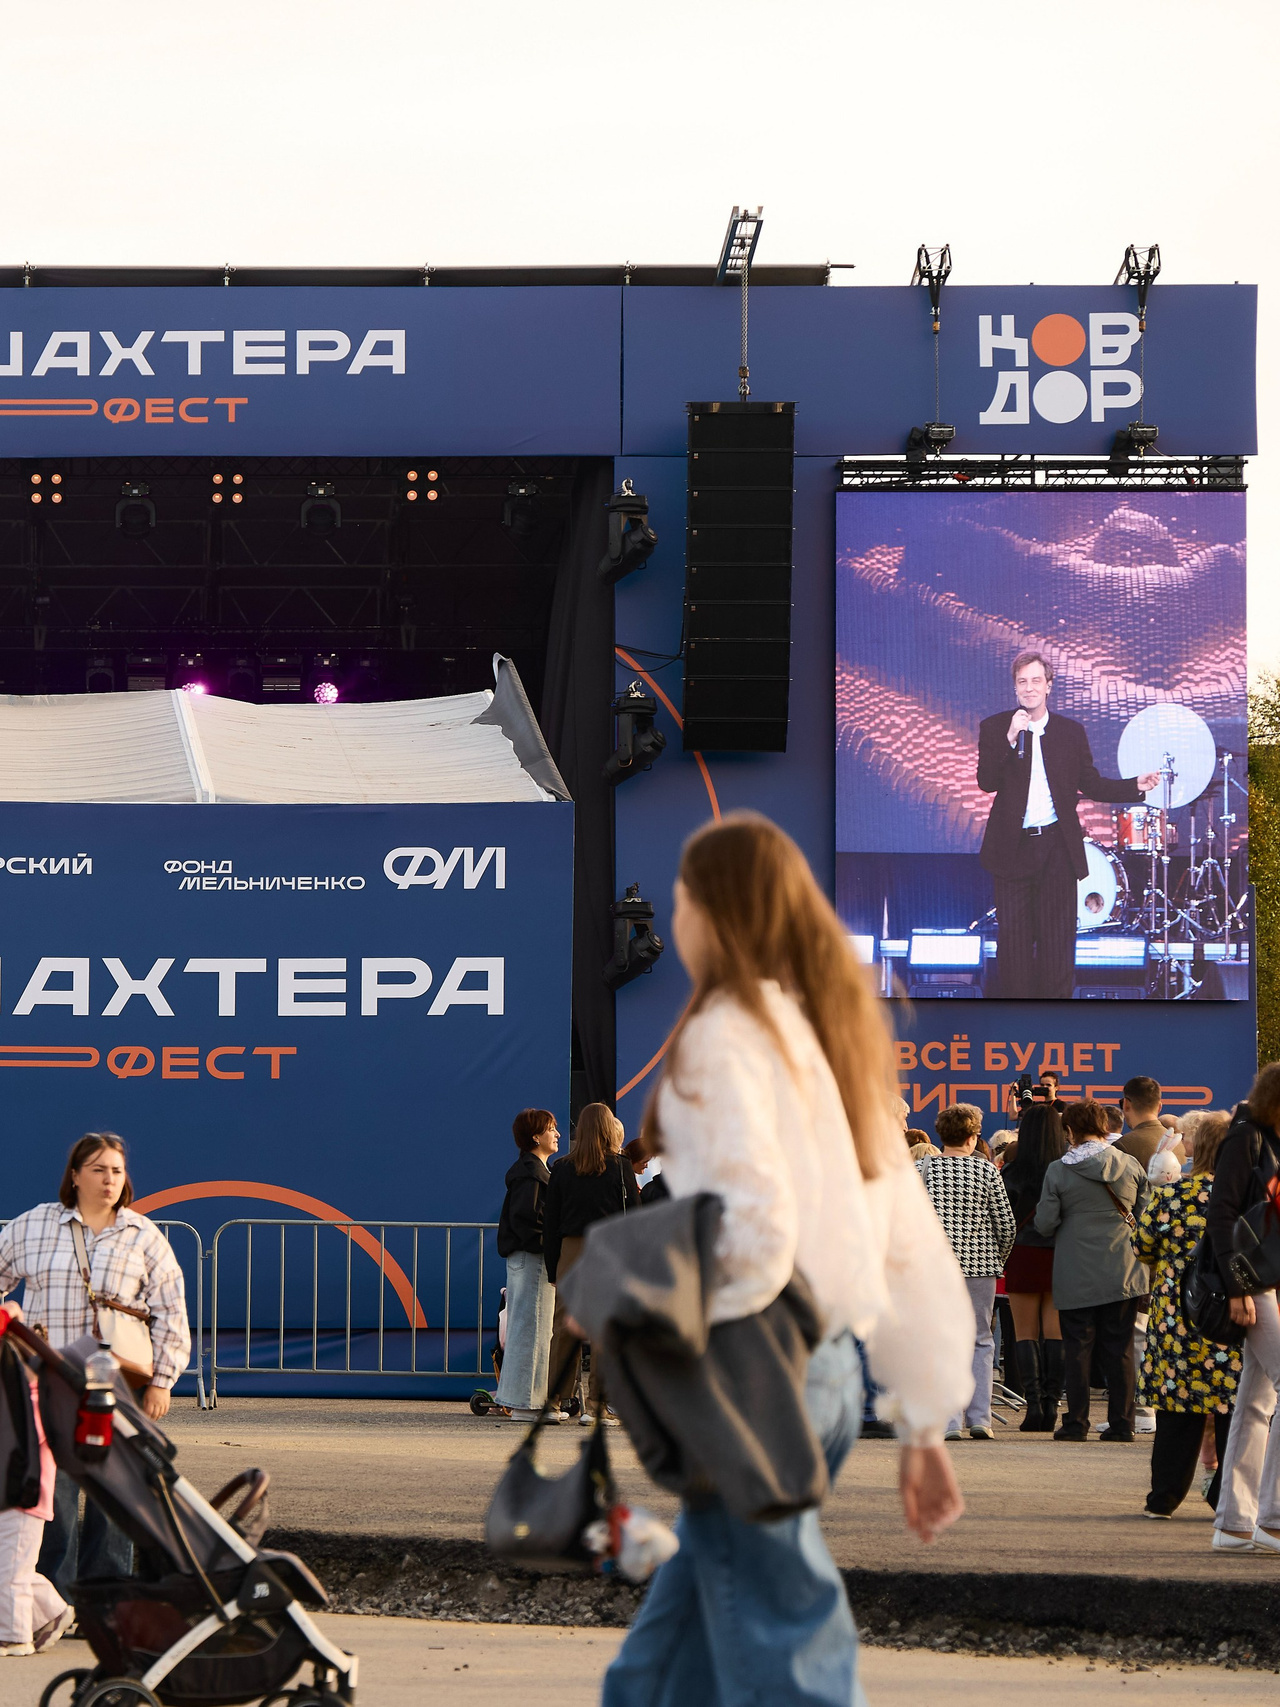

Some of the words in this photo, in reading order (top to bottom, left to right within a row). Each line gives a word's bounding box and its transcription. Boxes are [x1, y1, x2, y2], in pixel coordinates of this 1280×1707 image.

[163, 860, 233, 874] ФОНД
[178, 876, 366, 891] МЕЛЬНИЧЕНКО
[894, 1033, 972, 1071] ВСЁ
[984, 1041, 1121, 1077] БУДЕТ
